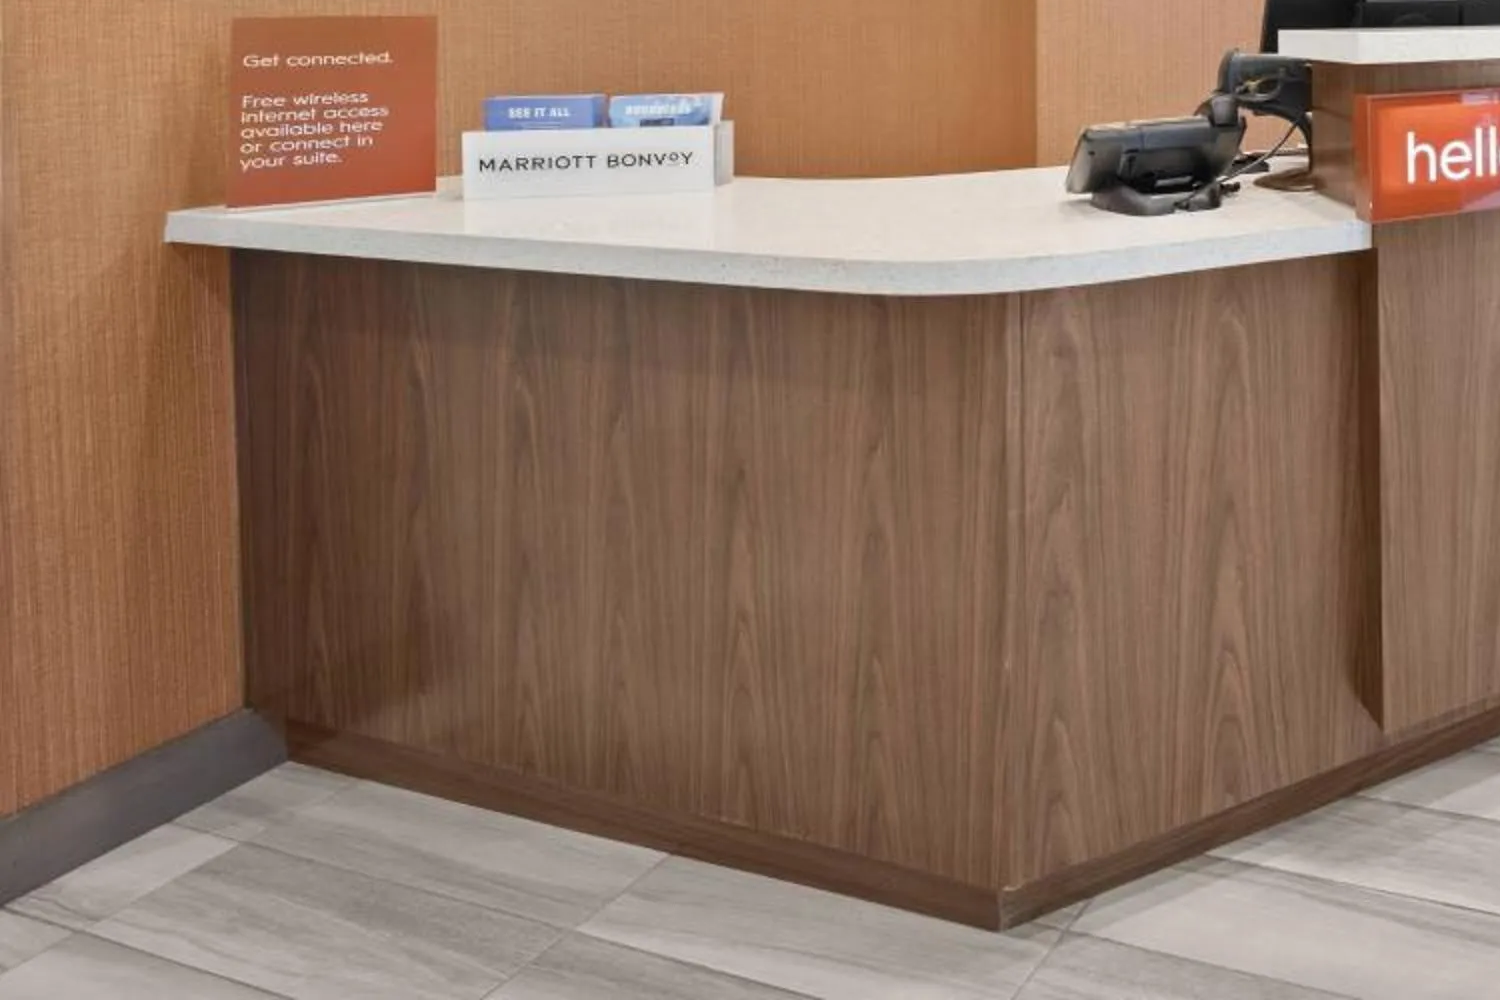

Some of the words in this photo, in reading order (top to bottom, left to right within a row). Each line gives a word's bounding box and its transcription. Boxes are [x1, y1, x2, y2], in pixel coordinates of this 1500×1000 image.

[243, 53, 280, 67] Get
[286, 51, 394, 67] connected.
[241, 95, 285, 109] Free
[292, 92, 369, 106] wireless
[241, 108, 317, 124] internet
[323, 107, 390, 119] access
[508, 107, 530, 119] SEE
[534, 106, 547, 118] IT
[549, 106, 571, 118] ALL
[240, 122, 334, 139] available
[340, 120, 383, 133] here
[240, 143, 262, 154] or
[270, 136, 350, 152] connect
[357, 135, 373, 147] in
[239, 156, 284, 173] your
[293, 151, 343, 165] suite.
[479, 154, 597, 172] MARRIOTT
[607, 151, 694, 168] BONVOY
